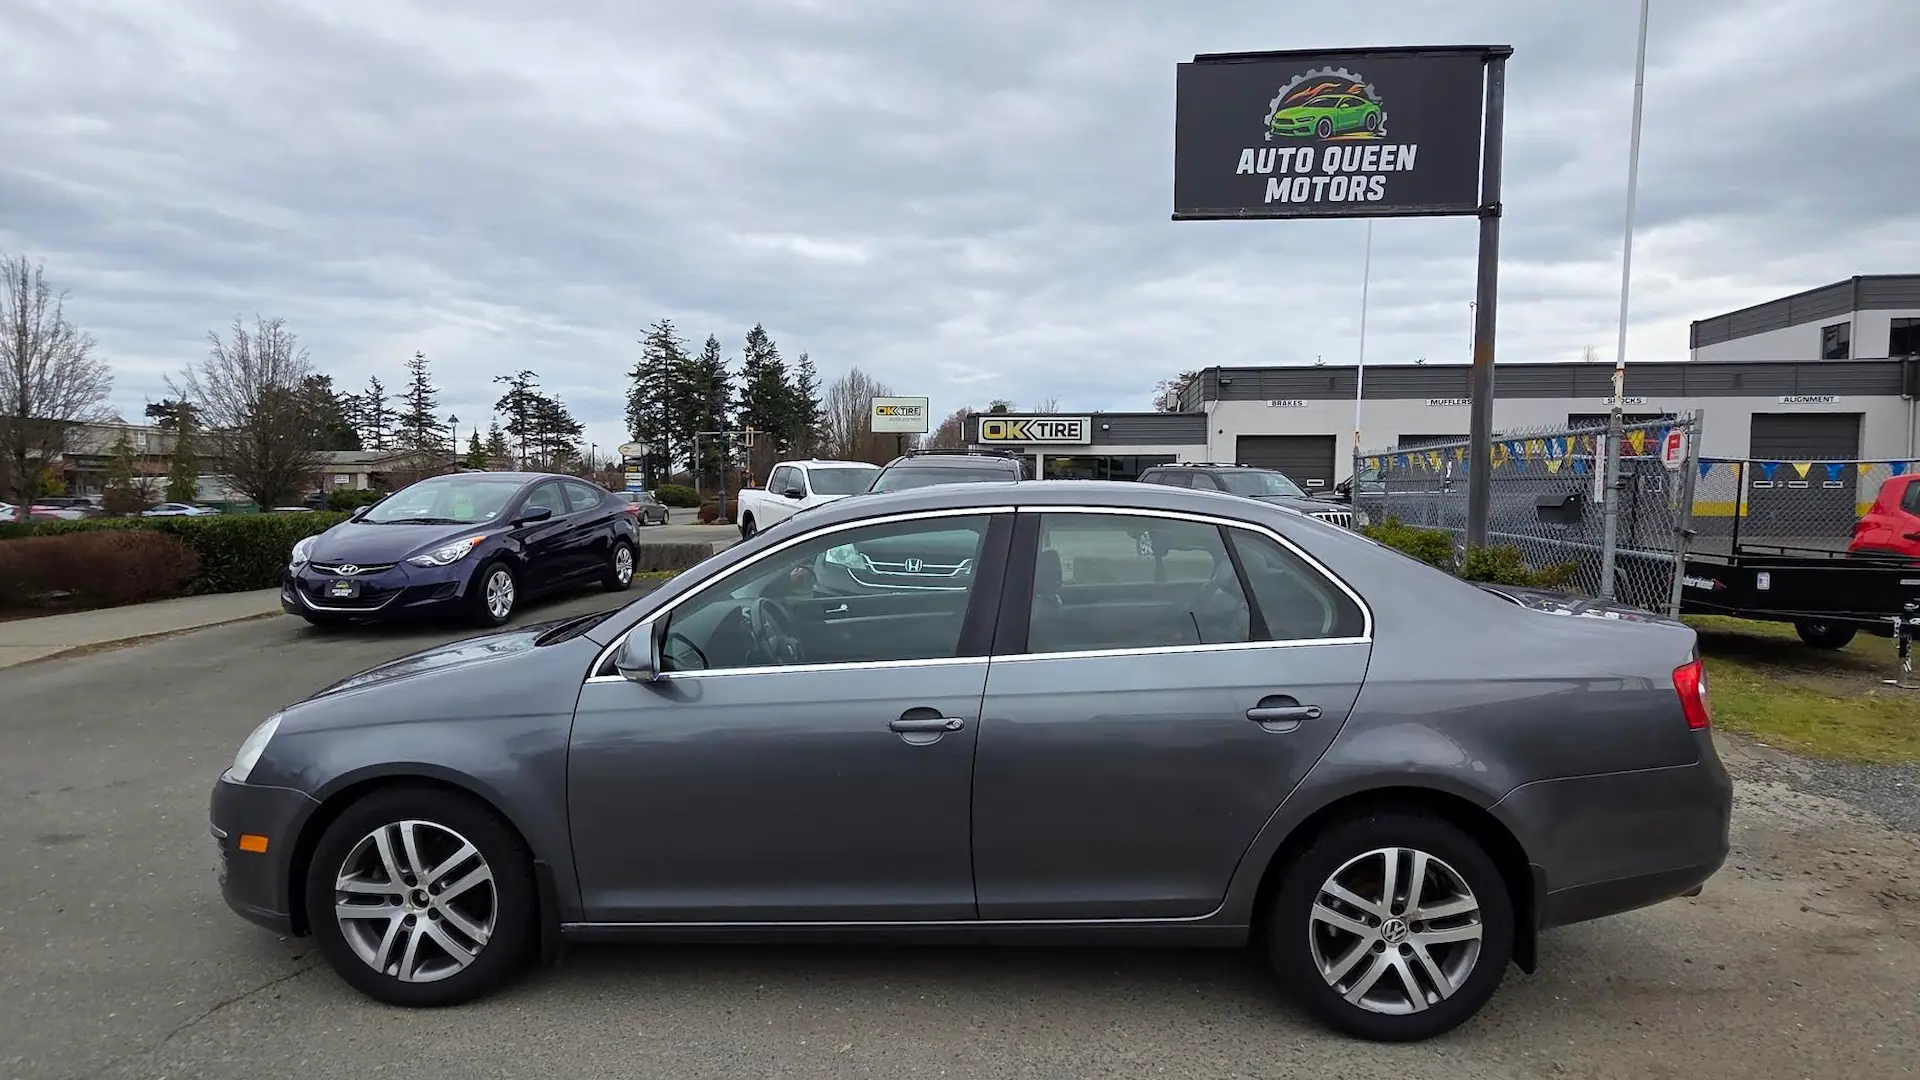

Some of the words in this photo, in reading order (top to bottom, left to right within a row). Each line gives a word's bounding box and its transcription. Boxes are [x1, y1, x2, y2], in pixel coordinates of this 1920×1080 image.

[1236, 147, 1315, 175] AUTO
[1322, 144, 1418, 175] QUEEN
[1264, 175, 1387, 203] MOTORS
[876, 406, 898, 416] OK
[900, 407, 921, 415] TIRE
[983, 420, 1031, 440] OK
[1037, 422, 1079, 437] TIRE
